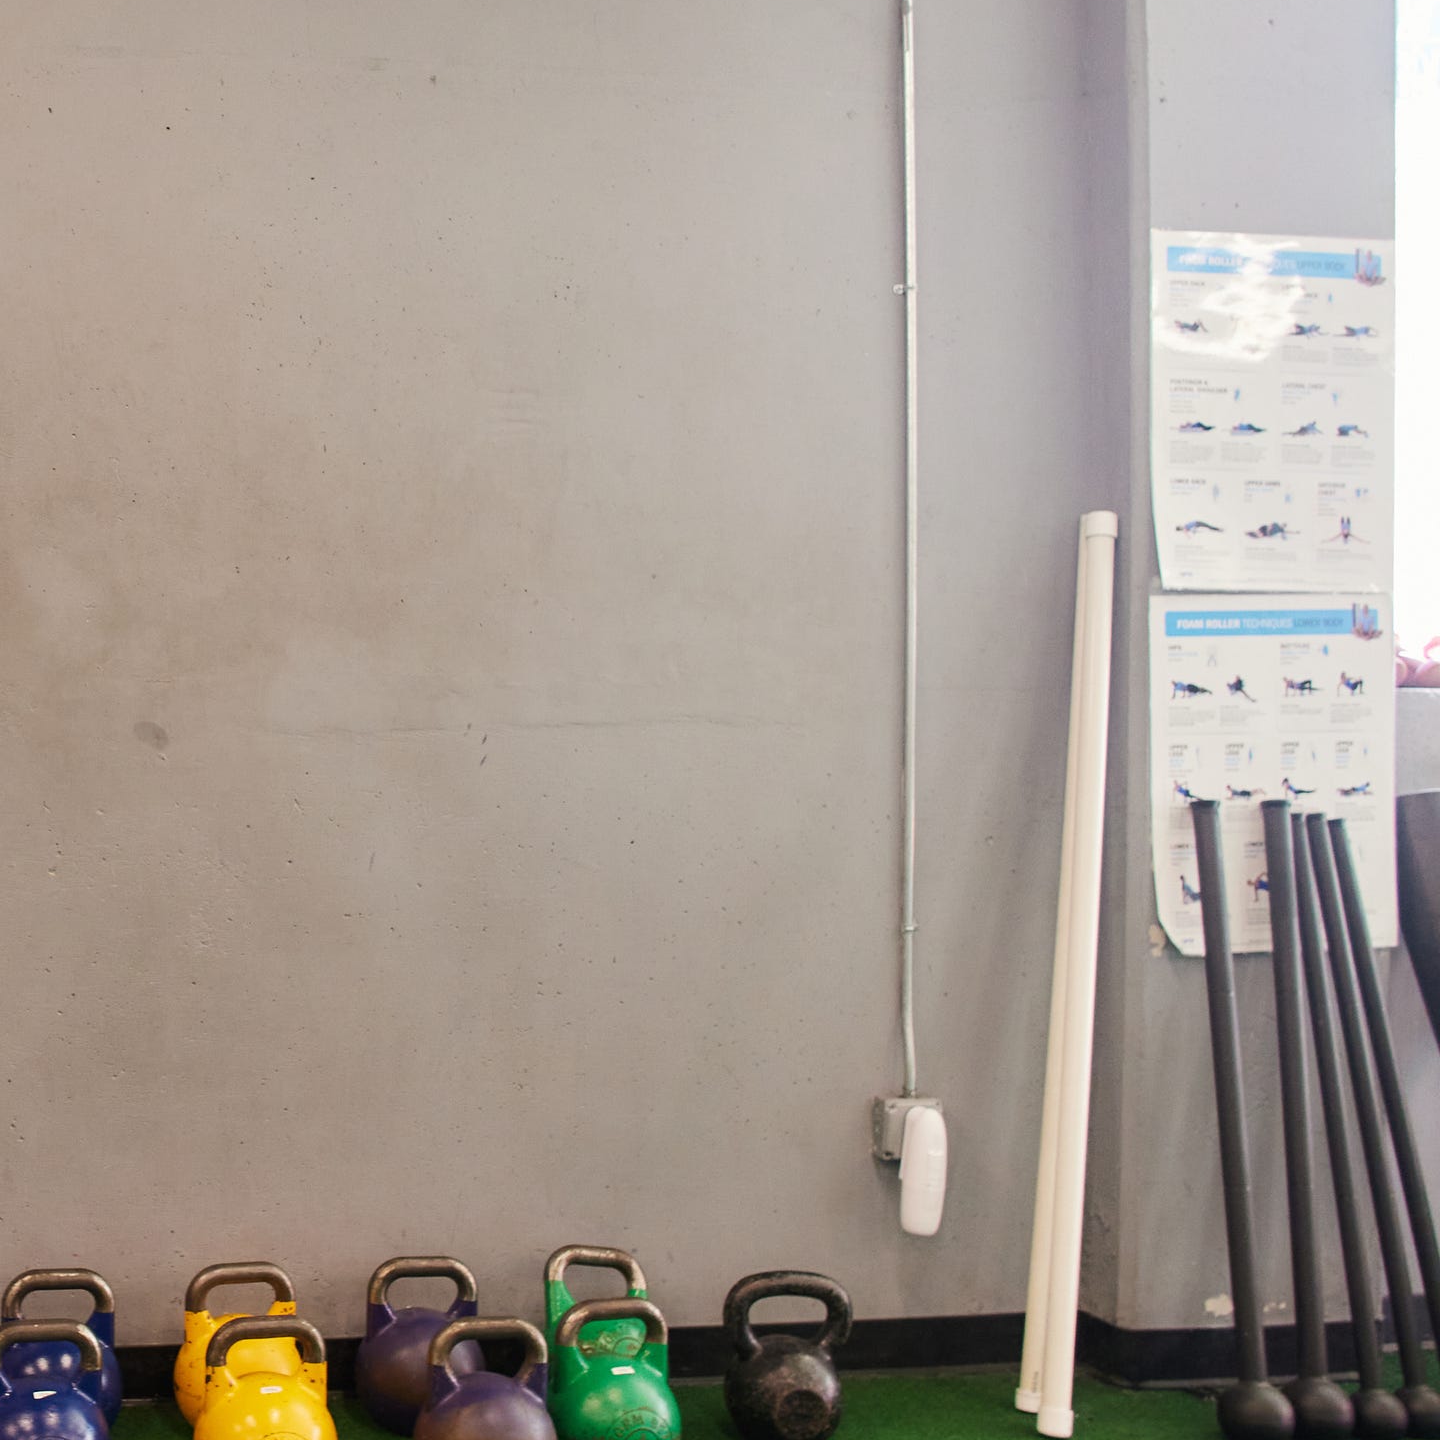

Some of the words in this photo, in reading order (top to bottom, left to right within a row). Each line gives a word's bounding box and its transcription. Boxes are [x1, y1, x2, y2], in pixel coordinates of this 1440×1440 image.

[1176, 618, 1204, 630] FOAM
[1205, 618, 1241, 629] ROLLER
[1242, 617, 1293, 629] TECHNIQUES
[1294, 616, 1321, 628] LOWER
[1322, 617, 1344, 627] BODY
